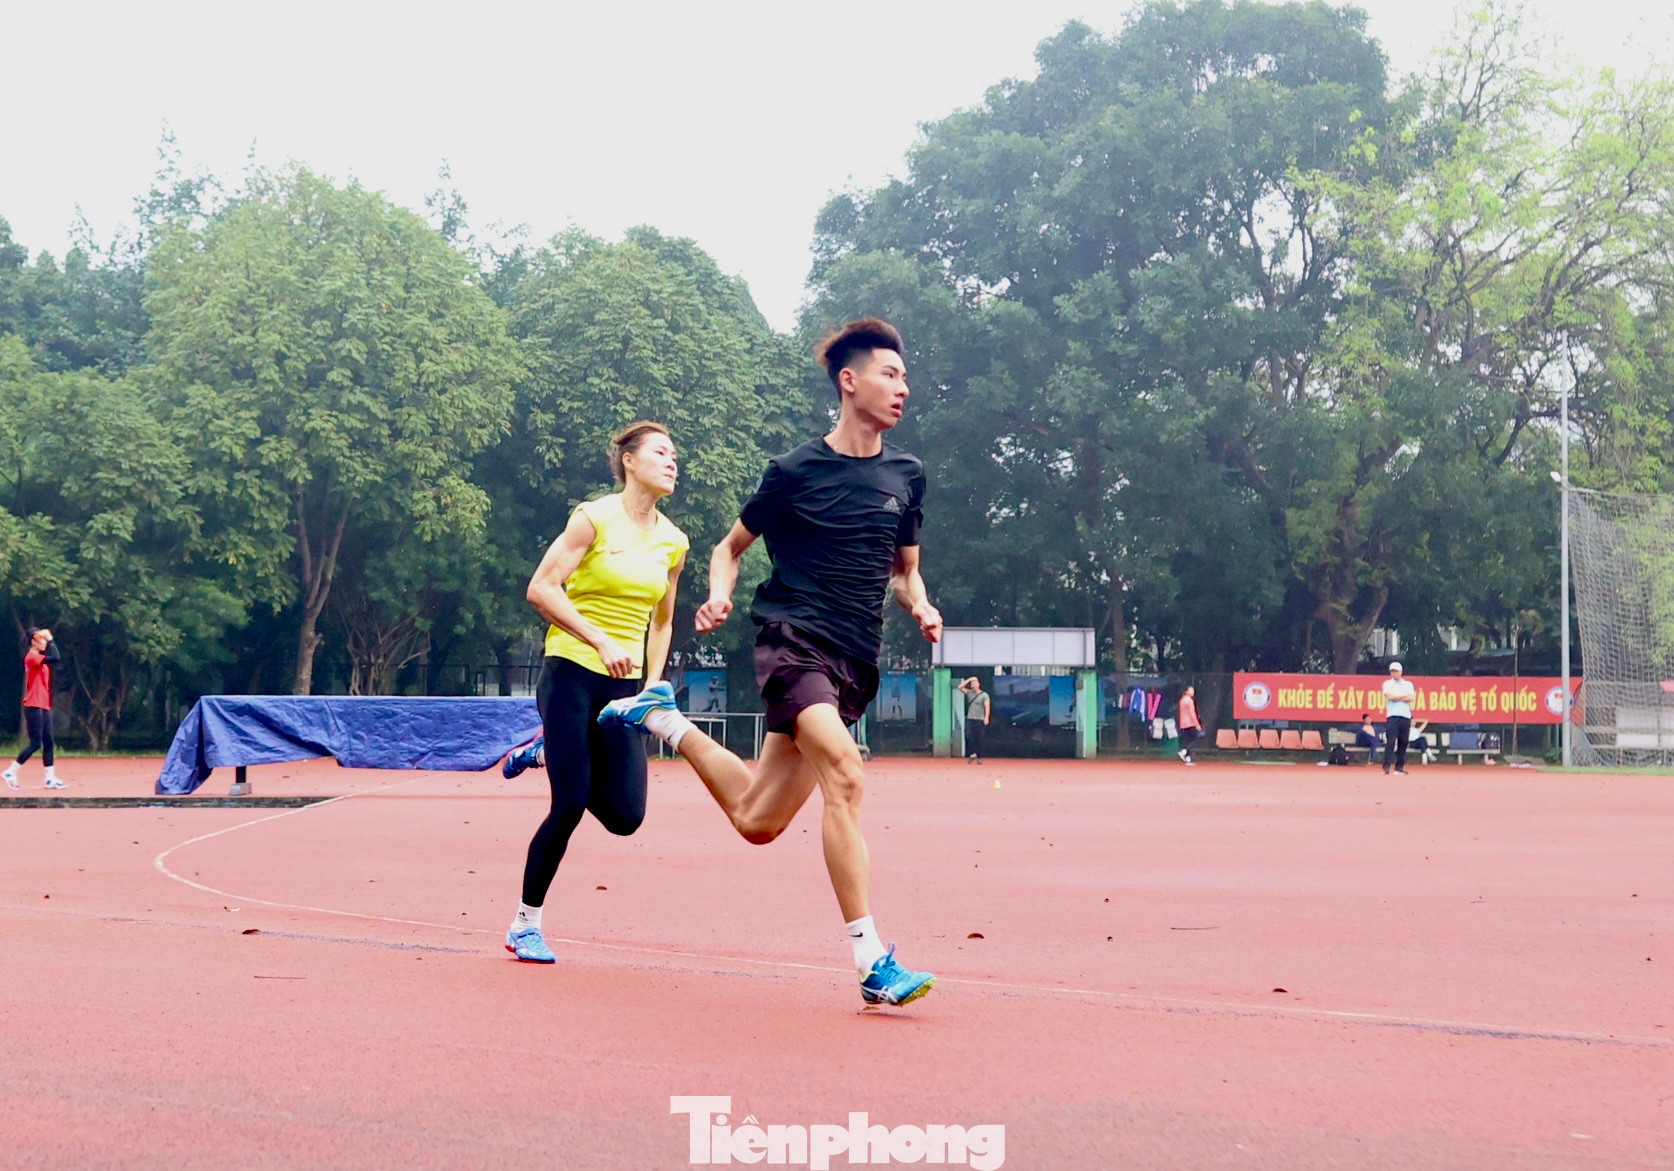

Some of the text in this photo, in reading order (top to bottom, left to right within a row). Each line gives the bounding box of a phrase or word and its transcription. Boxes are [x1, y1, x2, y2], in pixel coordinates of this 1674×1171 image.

[1278, 683, 1313, 709] KHỎE
[1338, 686, 1364, 710] XÂY
[1430, 686, 1457, 711] BẢO
[1460, 688, 1477, 715] VỆ
[1501, 686, 1537, 713] QUỐC
